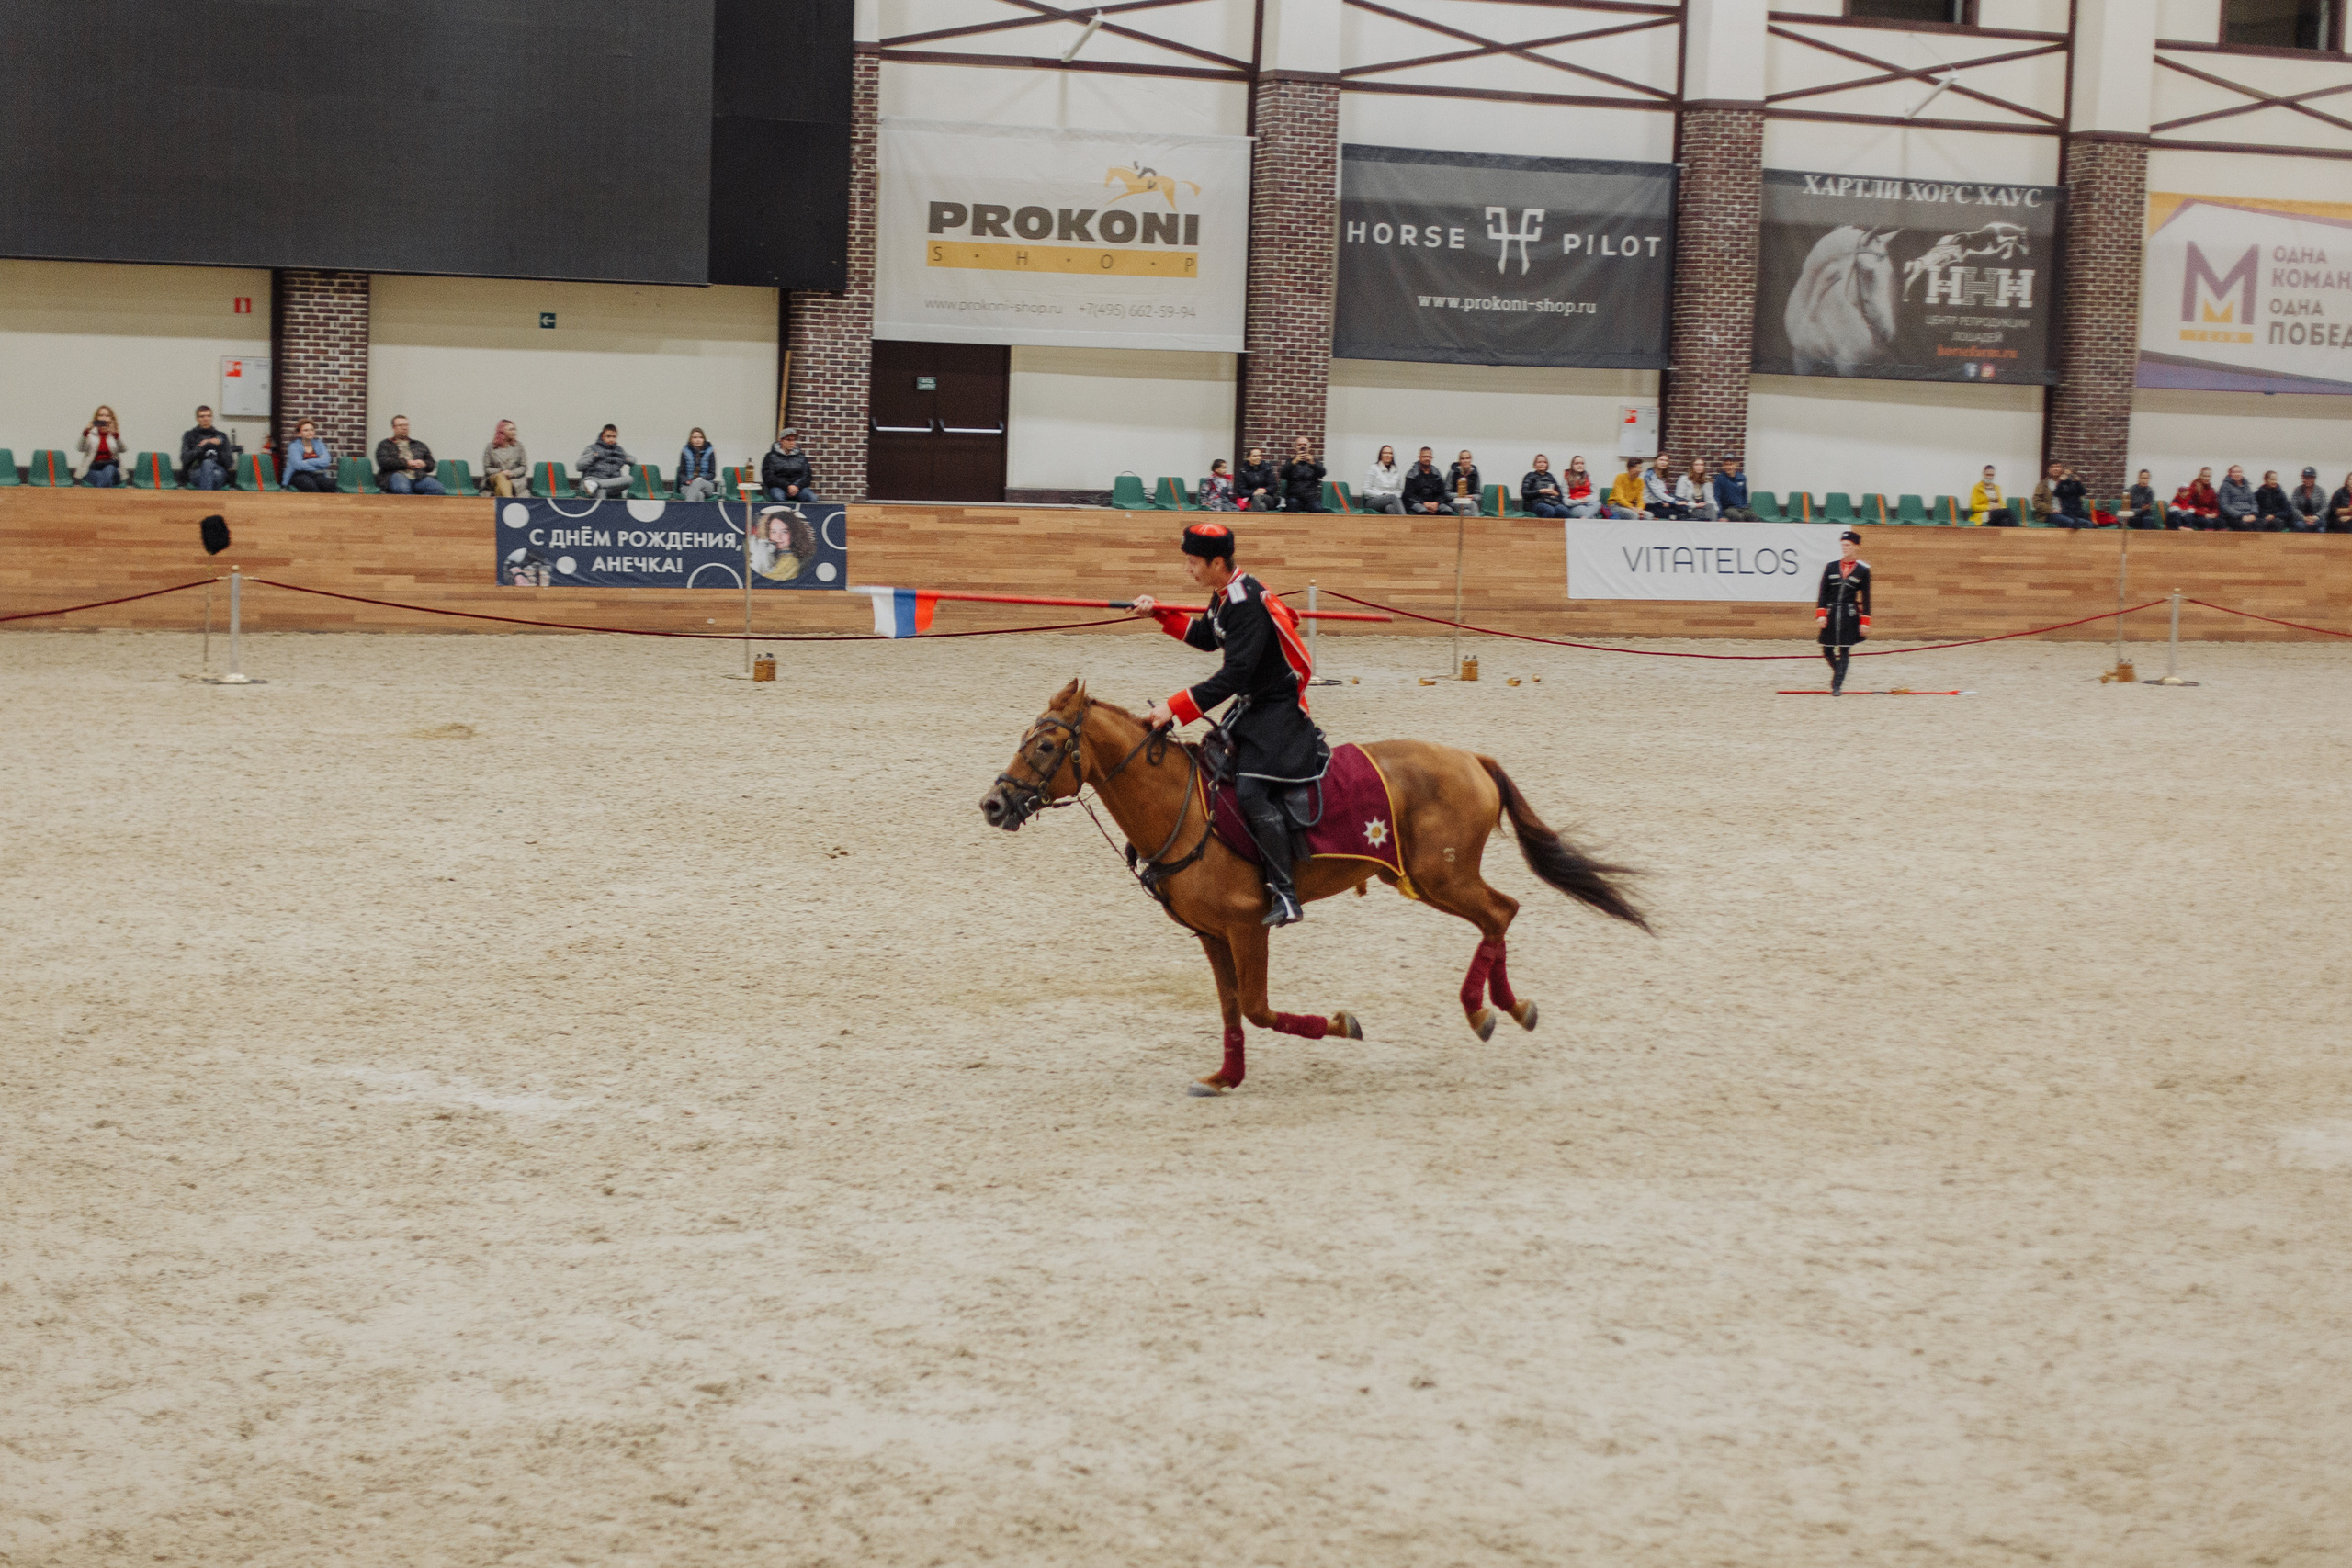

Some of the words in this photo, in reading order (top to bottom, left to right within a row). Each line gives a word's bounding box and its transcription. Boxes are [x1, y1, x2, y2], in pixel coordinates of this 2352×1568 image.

[1802, 175, 1902, 200] ХАРТЛИ
[1906, 182, 1973, 204] ХОРС
[1975, 186, 2042, 208] ХАУС
[928, 200, 1200, 246] PROKONI
[1346, 221, 1465, 249] HORSE
[1563, 233, 1662, 257] PILOT
[2273, 245, 2328, 265] ОДНА
[924, 299, 1063, 315] www.prokoni-shop.ru
[1418, 295, 1597, 316] www.prokoni-shop.ru
[2269, 298, 2324, 316] ОДНА
[529, 528, 545, 546] С
[549, 526, 612, 548] ДНЁМ
[617, 531, 742, 551] РОЖДЕНИЯ,
[591, 556, 683, 573] АНЕЧКА!
[1622, 546, 1800, 576] VITATELOS
